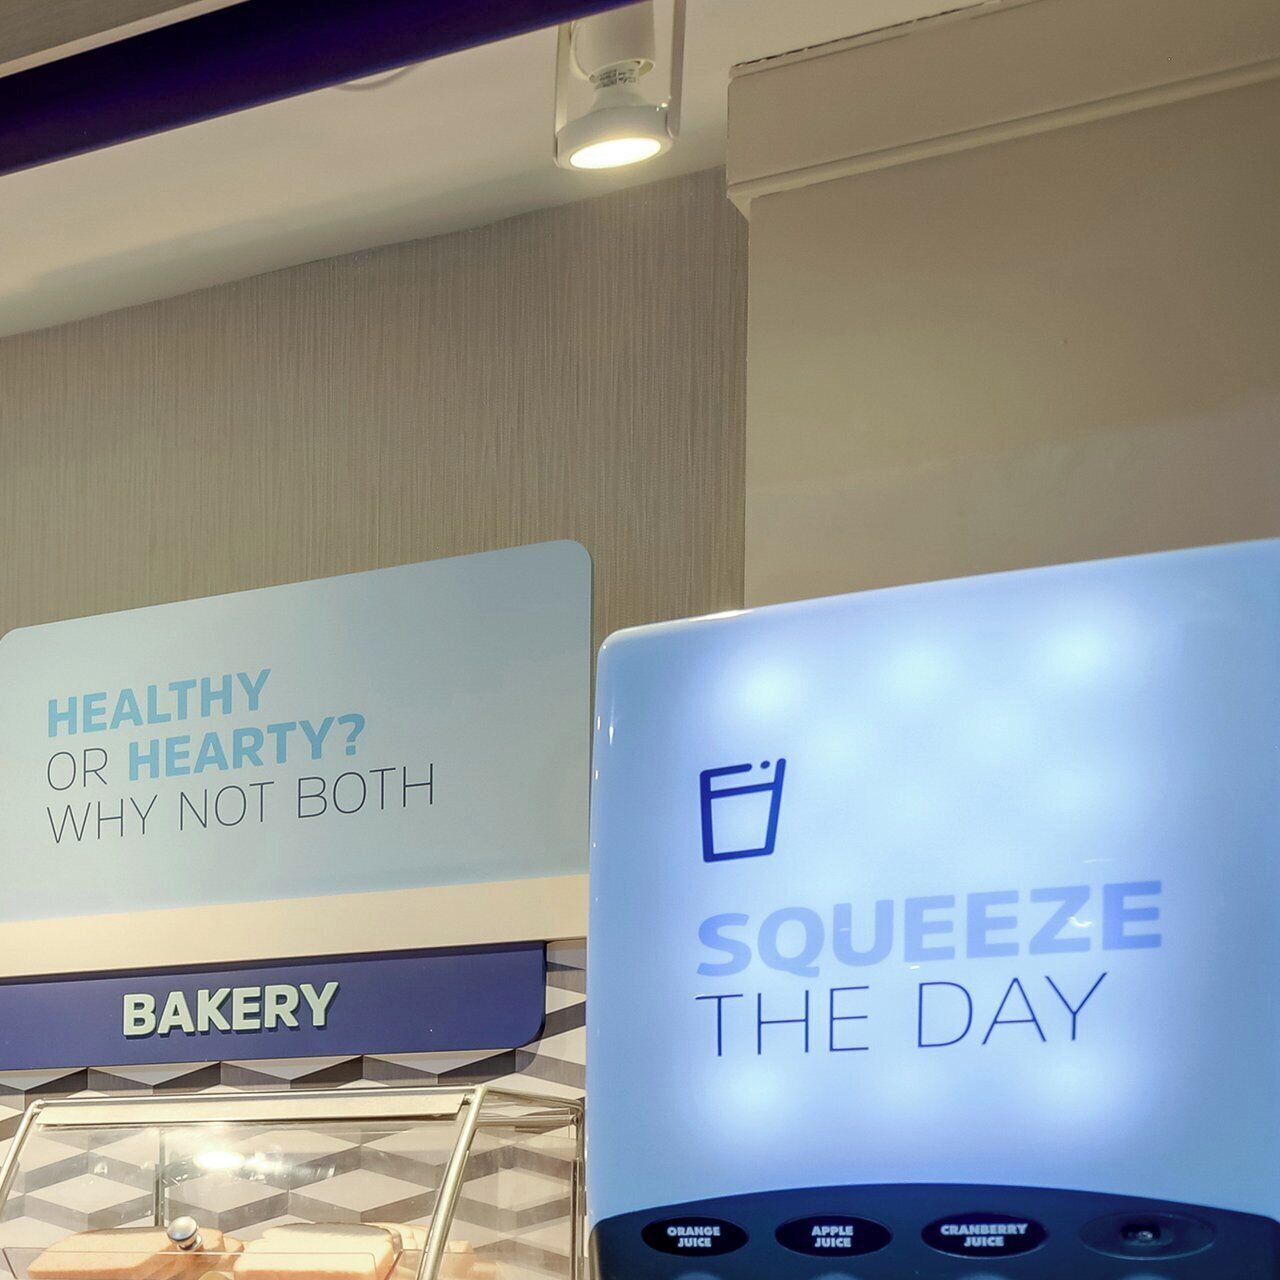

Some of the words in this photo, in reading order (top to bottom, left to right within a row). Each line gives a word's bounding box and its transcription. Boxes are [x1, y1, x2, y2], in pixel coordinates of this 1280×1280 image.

[46, 667, 272, 738] HEALTHY
[46, 747, 109, 791] OR
[128, 712, 366, 781] HEARTY?
[46, 794, 159, 845] WHY
[180, 780, 275, 832] NOT
[297, 762, 434, 819] BOTH
[696, 879, 1162, 978] SQUEEZE
[122, 981, 340, 1038] BAKERY
[693, 984, 870, 1057] THE
[916, 971, 1108, 1049] DAY
[667, 1226, 721, 1237] ORANGE
[677, 1237, 712, 1248] JUICE
[811, 1225, 854, 1237] APPLE
[814, 1237, 852, 1248] JUICE
[940, 1223, 1029, 1236] CRANBERRY
[963, 1236, 1005, 1248] JUICE
